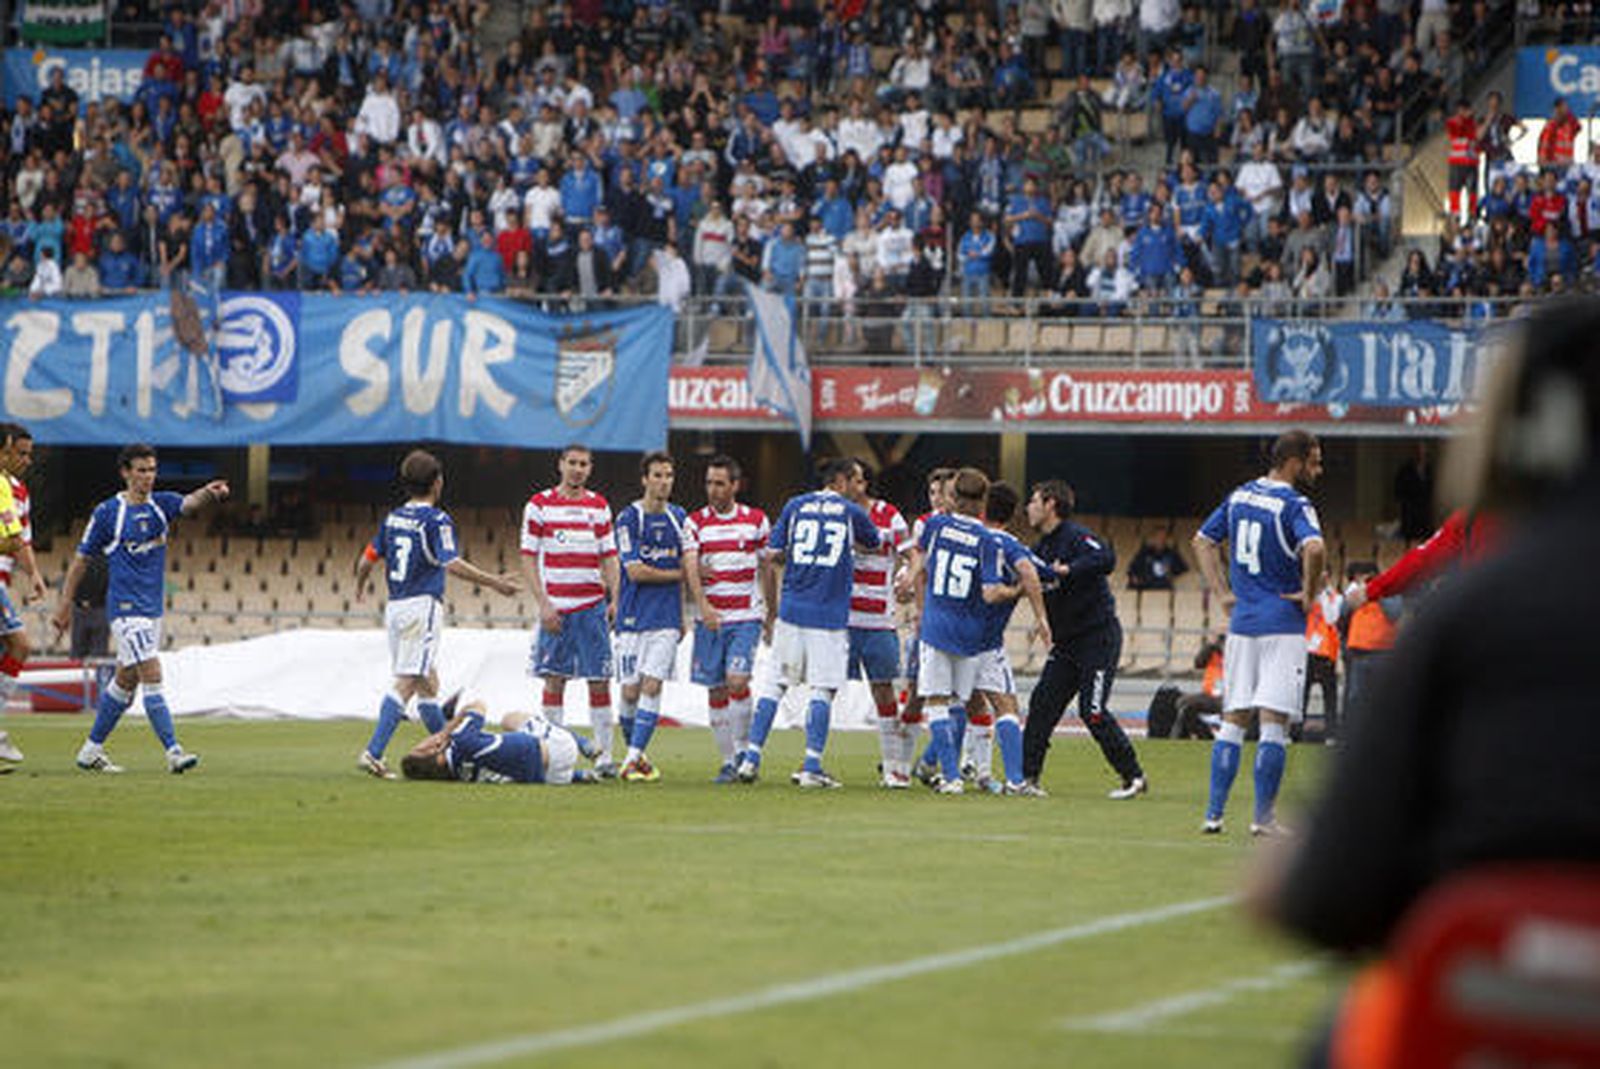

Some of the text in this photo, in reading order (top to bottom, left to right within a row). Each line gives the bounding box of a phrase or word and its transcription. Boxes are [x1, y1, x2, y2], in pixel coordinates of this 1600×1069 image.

[339, 306, 516, 417] SUR
[1050, 374, 1223, 419] Cruzcampo
[390, 536, 412, 582] 3
[792, 519, 846, 567] 23
[1236, 519, 1261, 575] 4
[933, 549, 978, 599] 15
